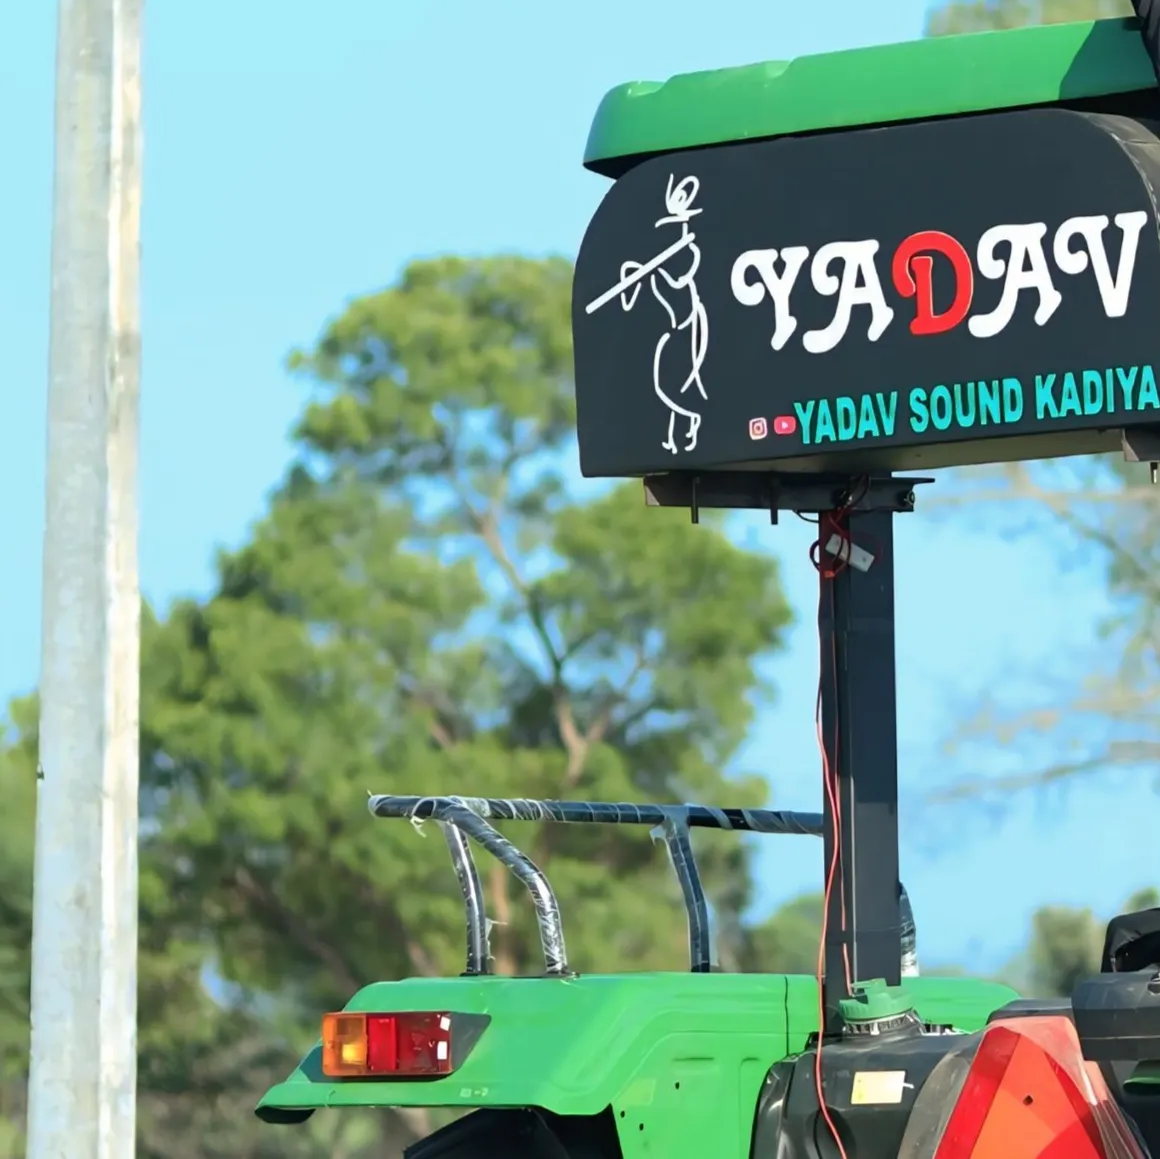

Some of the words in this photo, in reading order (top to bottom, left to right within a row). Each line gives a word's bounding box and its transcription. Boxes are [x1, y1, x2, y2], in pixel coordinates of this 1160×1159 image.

[730, 210, 1148, 354] YADAV
[793, 391, 898, 444] YADAV
[909, 377, 1024, 433] SOUND
[1035, 365, 1160, 420] KADIYA
